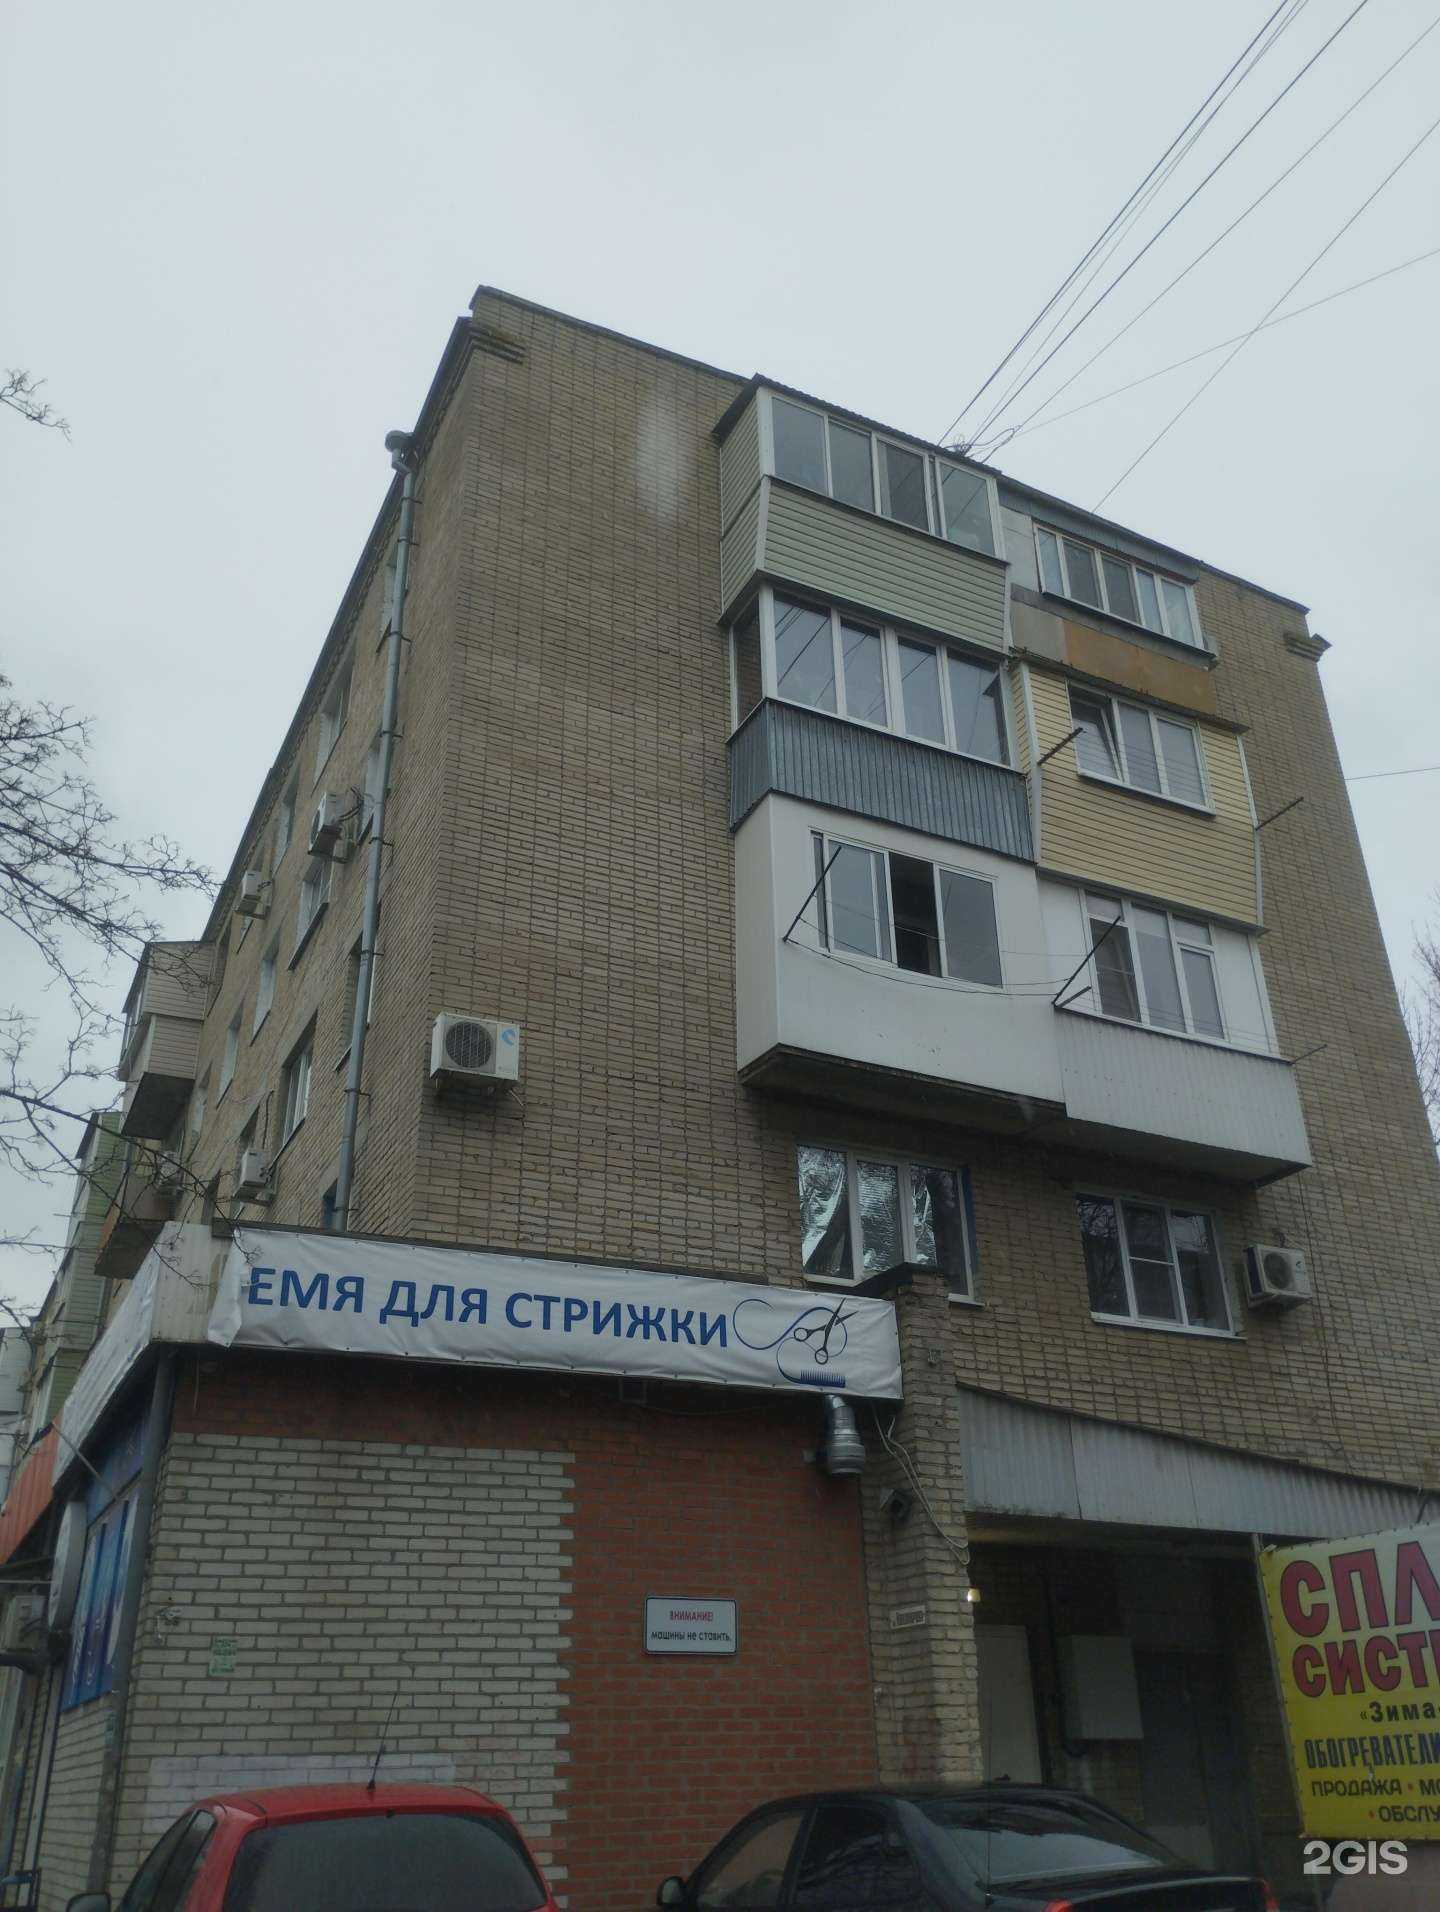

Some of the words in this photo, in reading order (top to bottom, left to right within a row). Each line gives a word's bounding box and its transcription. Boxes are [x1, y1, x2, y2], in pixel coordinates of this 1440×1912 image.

[378, 1279, 488, 1327] ДЛЯ
[504, 1293, 729, 1348] СТРИЖКИ
[1279, 1541, 1440, 1638] СПЛ
[1359, 1700, 1440, 1723] «Зима
[1311, 1779, 1402, 1797] ПРОДАЖА
